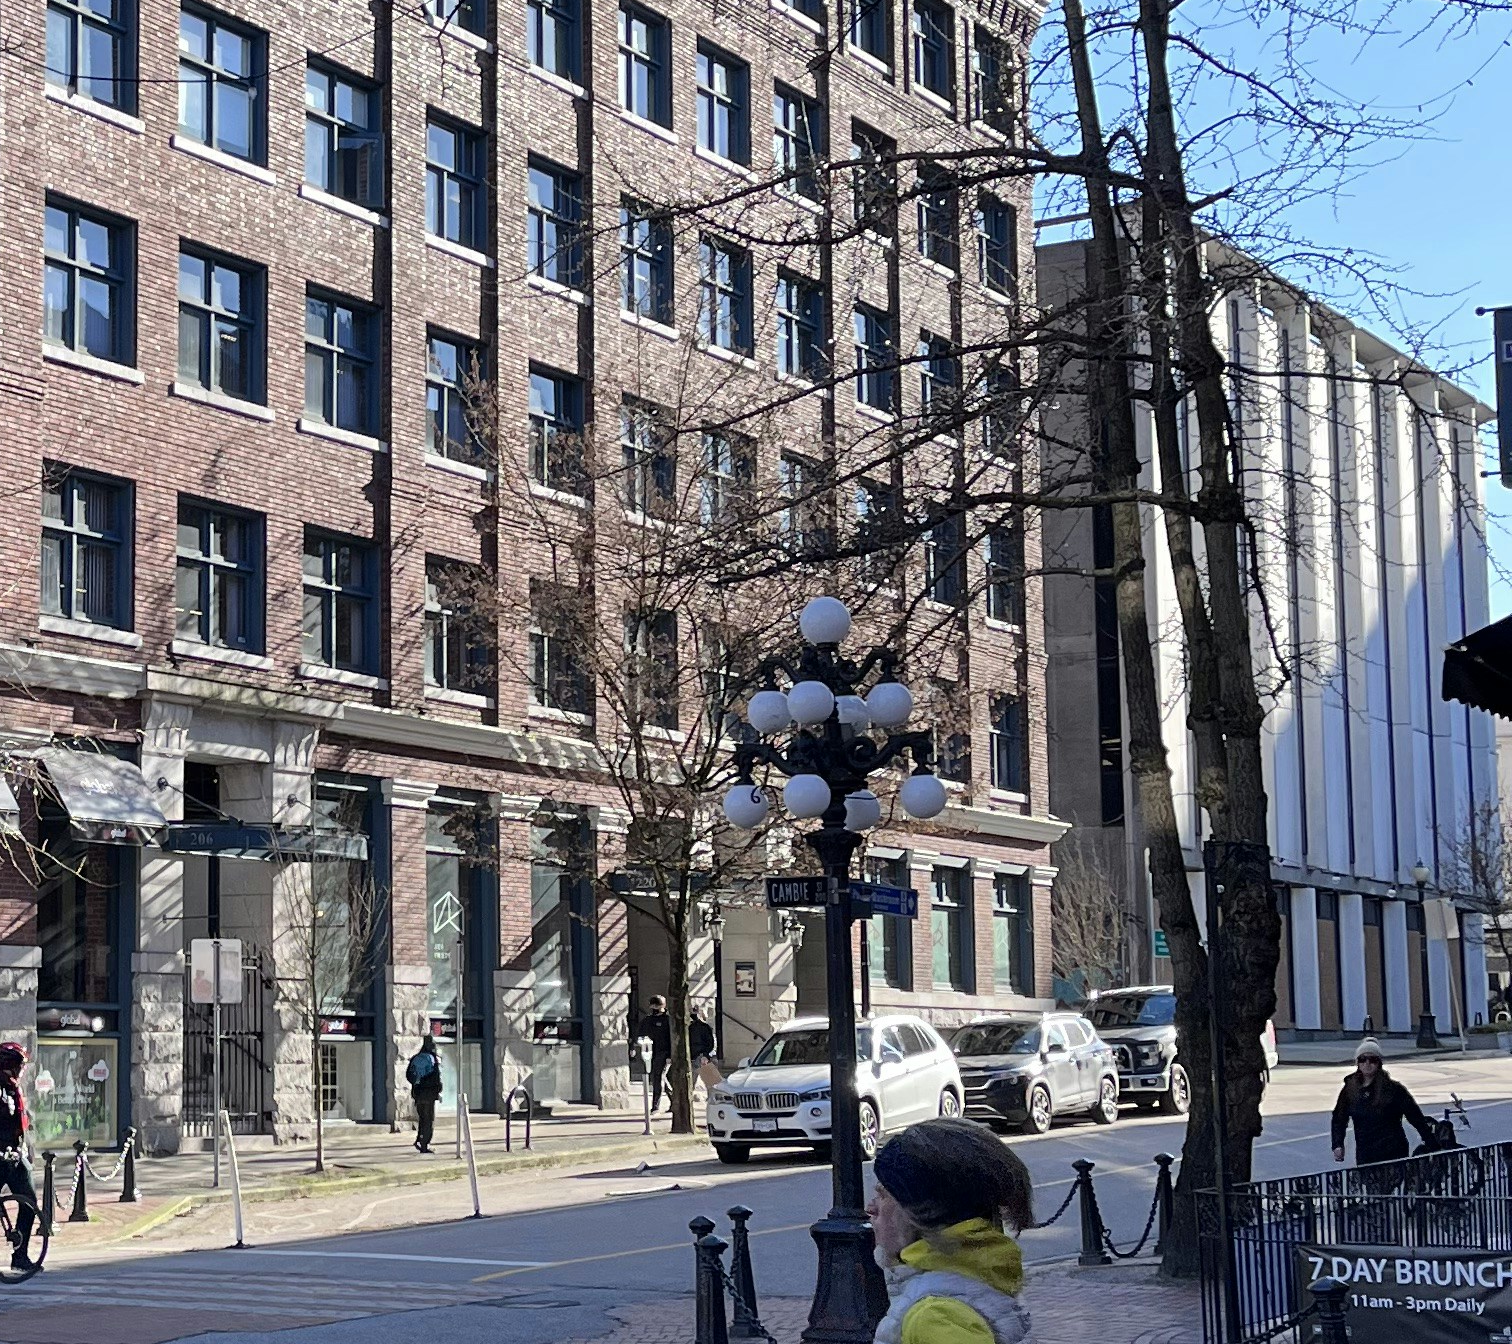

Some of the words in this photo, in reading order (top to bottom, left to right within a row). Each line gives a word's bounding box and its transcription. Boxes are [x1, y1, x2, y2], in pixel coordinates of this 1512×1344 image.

[190, 832, 214, 846] 206
[636, 876, 656, 889] 220
[771, 882, 809, 903] CAMBIE
[1308, 1256, 1324, 1280] 7
[1332, 1257, 1387, 1283] DAY
[1395, 1259, 1512, 1288] BRUNCH
[1351, 1294, 1393, 1309] 11am
[1405, 1296, 1441, 1313] 3pm
[1445, 1298, 1486, 1316] Daily
